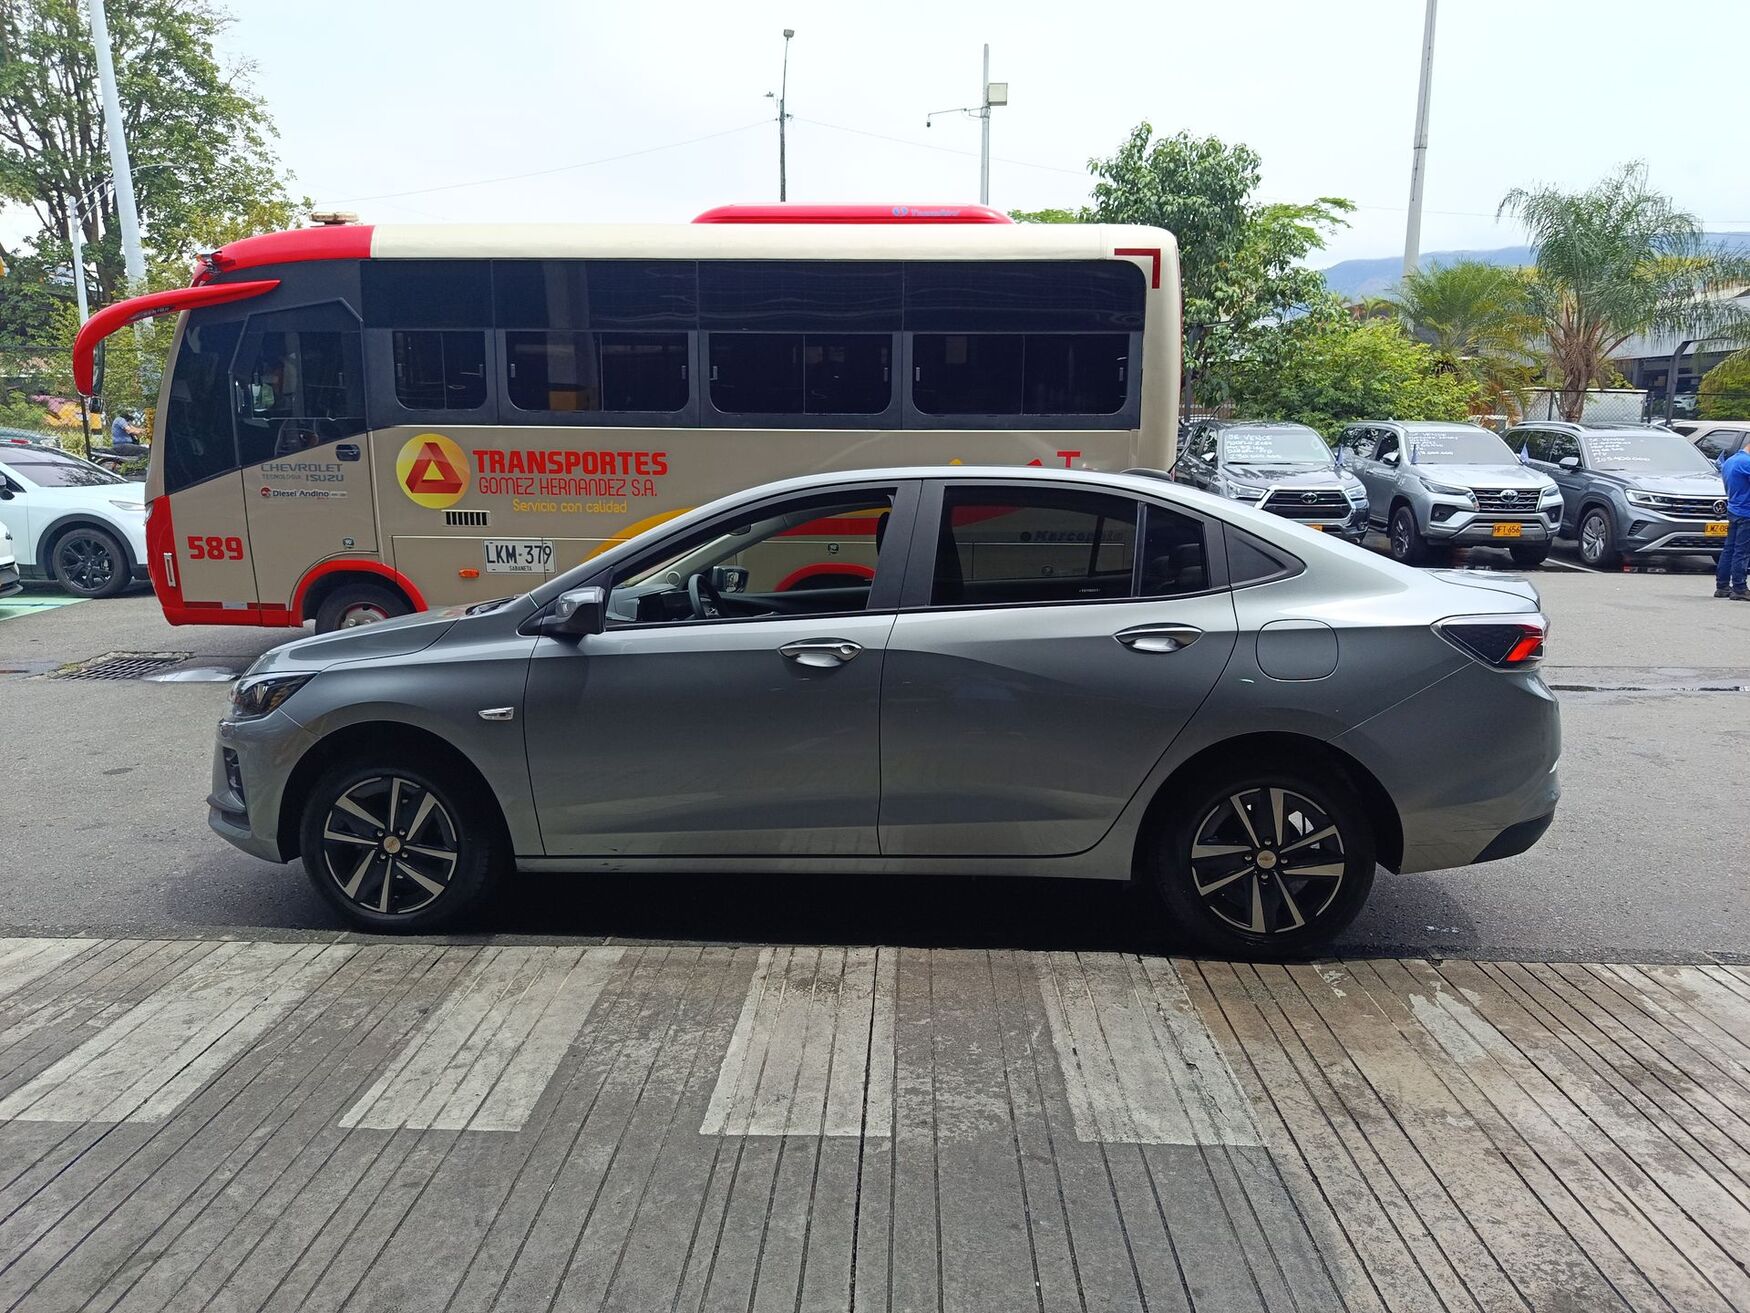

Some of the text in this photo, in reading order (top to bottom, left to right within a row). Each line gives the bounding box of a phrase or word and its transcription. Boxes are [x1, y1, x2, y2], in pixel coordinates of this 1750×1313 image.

[261, 463, 343, 472] CHEVROLET
[472, 450, 669, 476] TRANSPORTES
[306, 474, 344, 482] ISUZU
[299, 490, 330, 498] Andino
[479, 477, 657, 497] GOMEZ HERNANDEZ S.A.
[513, 498, 628, 513] Servicio con calidad
[187, 535, 244, 560] 589
[485, 544, 552, 565] LKM-379
